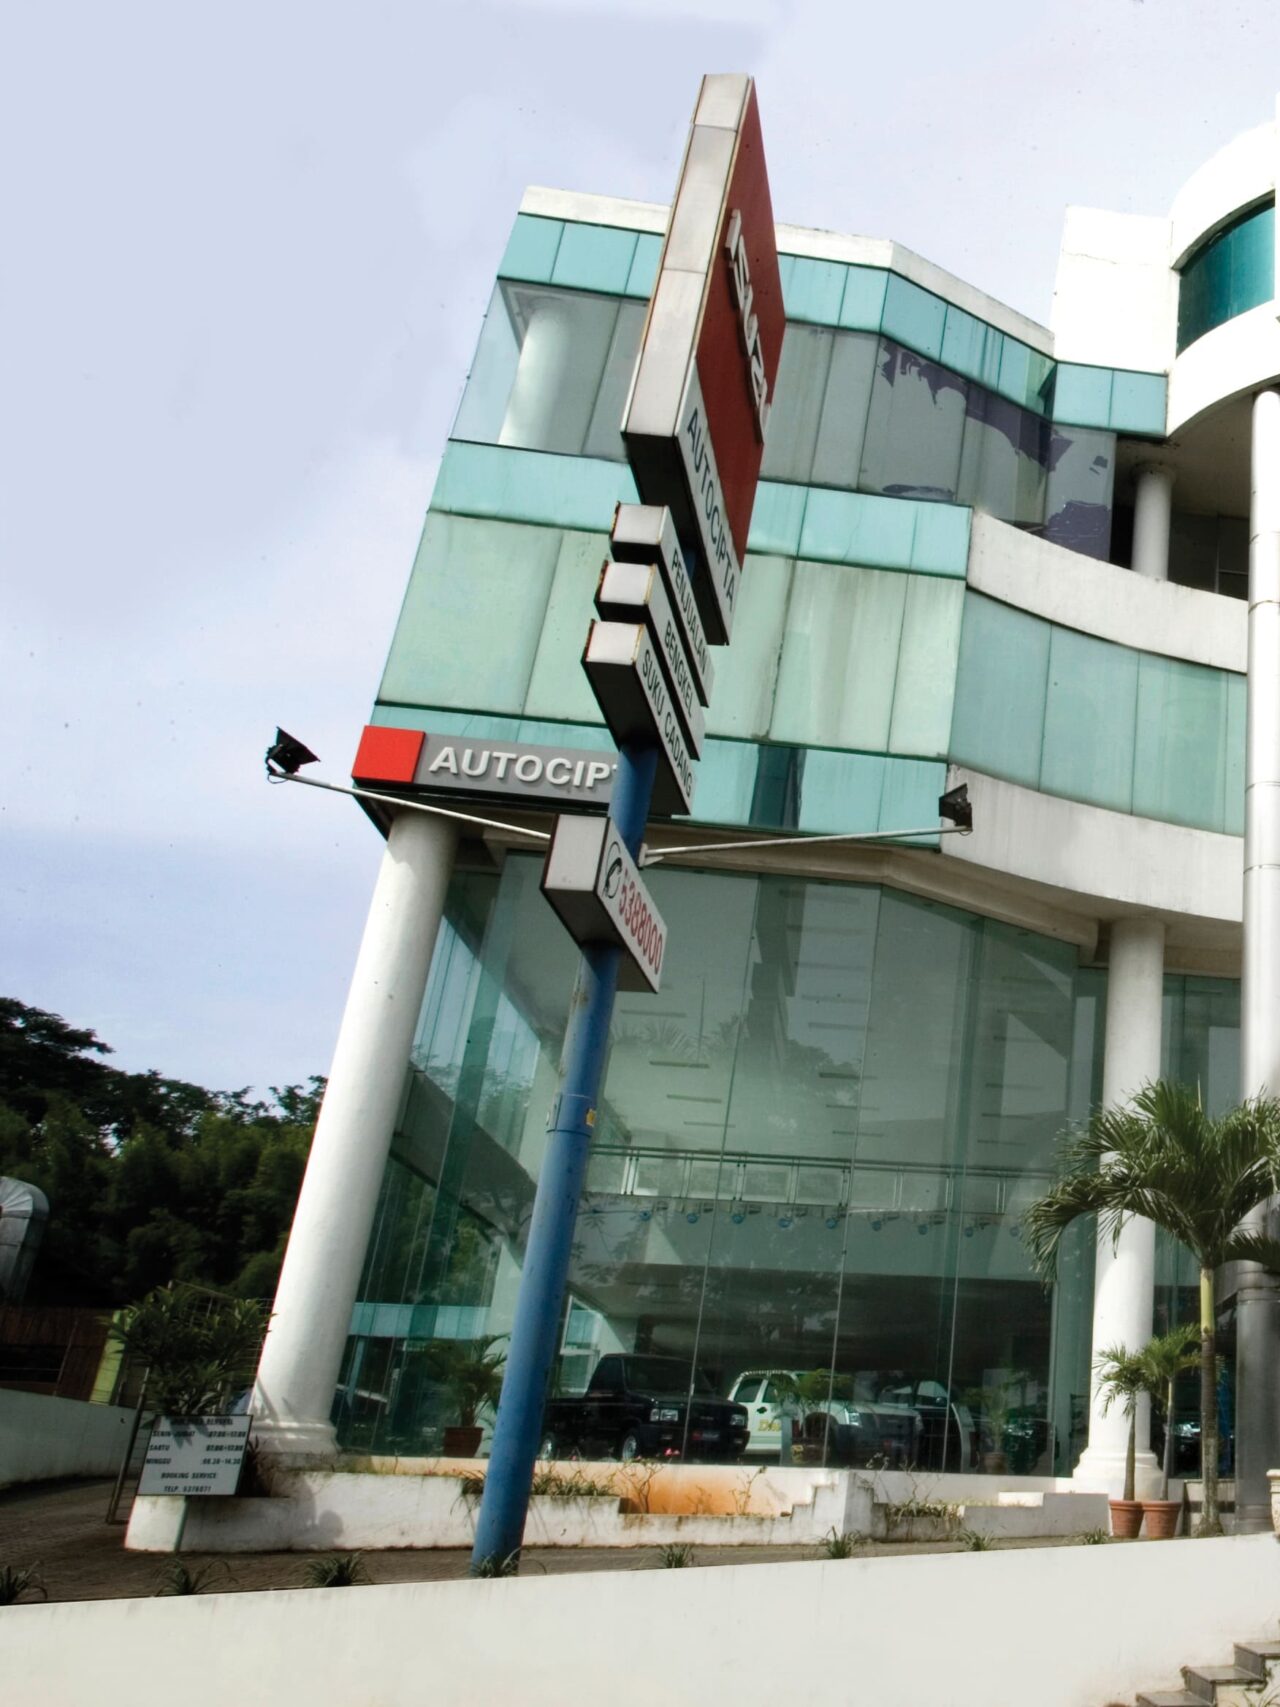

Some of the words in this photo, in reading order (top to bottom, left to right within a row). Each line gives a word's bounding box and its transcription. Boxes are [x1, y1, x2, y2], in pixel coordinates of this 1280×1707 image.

[687, 407, 736, 612] AUTOCIPTA
[664, 620, 694, 719] BENGKEL
[671, 547, 707, 676] PENJUALAN
[429, 746, 618, 789] AUTOCIP
[642, 648, 665, 717] SUKU
[664, 711, 693, 798] CADANG
